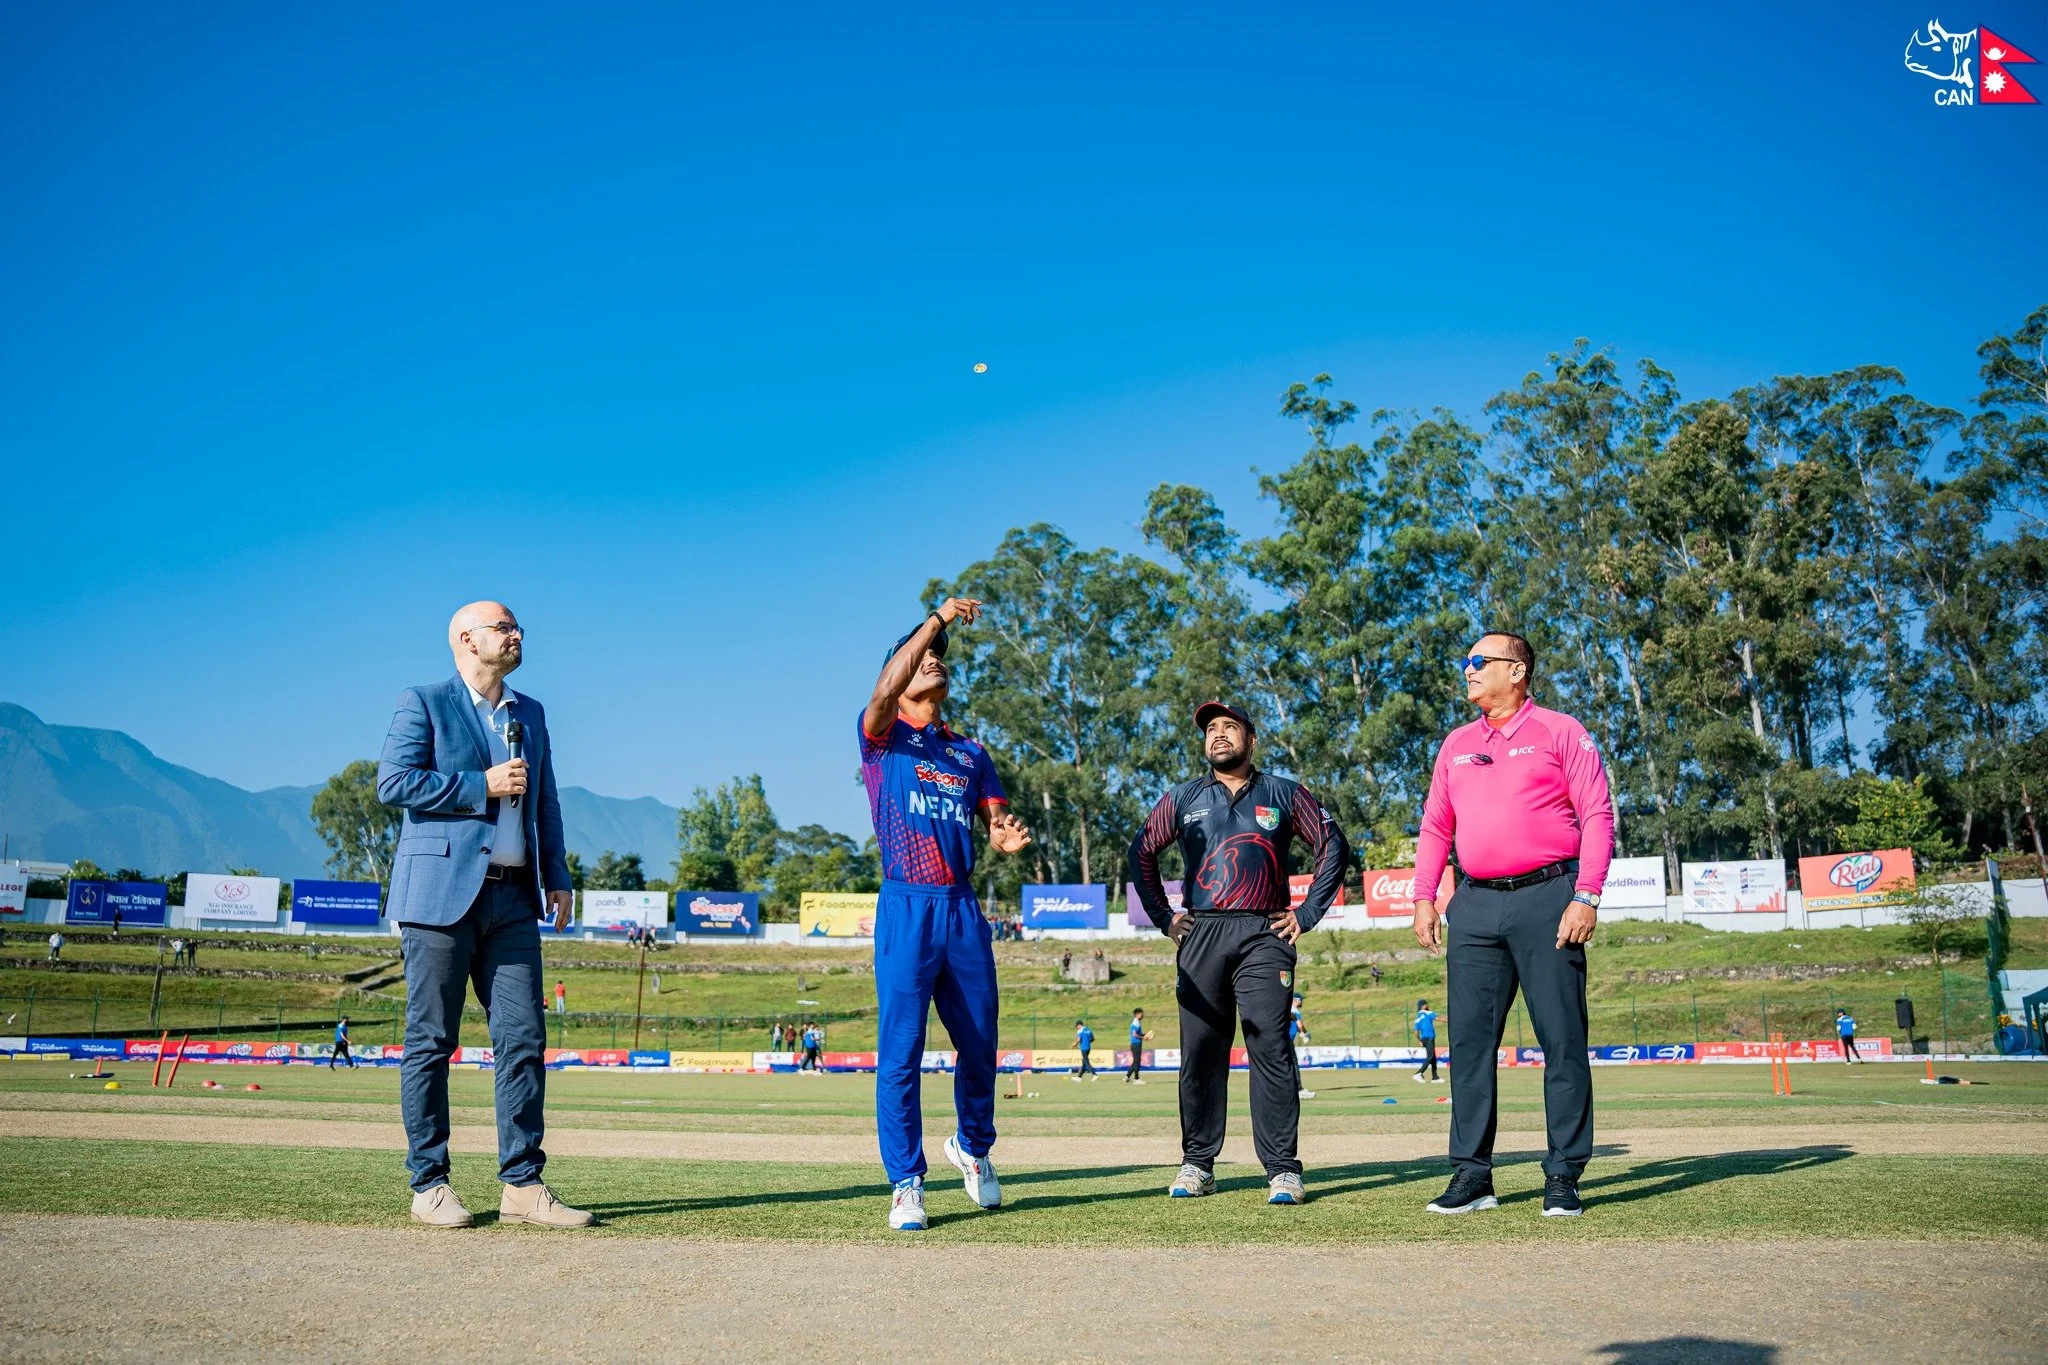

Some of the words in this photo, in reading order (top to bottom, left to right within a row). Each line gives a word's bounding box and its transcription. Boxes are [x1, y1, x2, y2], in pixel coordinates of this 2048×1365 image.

[1518, 746, 1536, 755] ICC
[915, 764, 969, 792] Second
[909, 790, 972, 830] NEPA
[1836, 856, 1877, 888] Real
[1372, 874, 1416, 901] Coca-C
[1604, 877, 1657, 888] orldRemit
[820, 900, 875, 909] Foodmand
[688, 1058, 744, 1066] Foodmandu
[1050, 1056, 1106, 1065] Foodmndu
